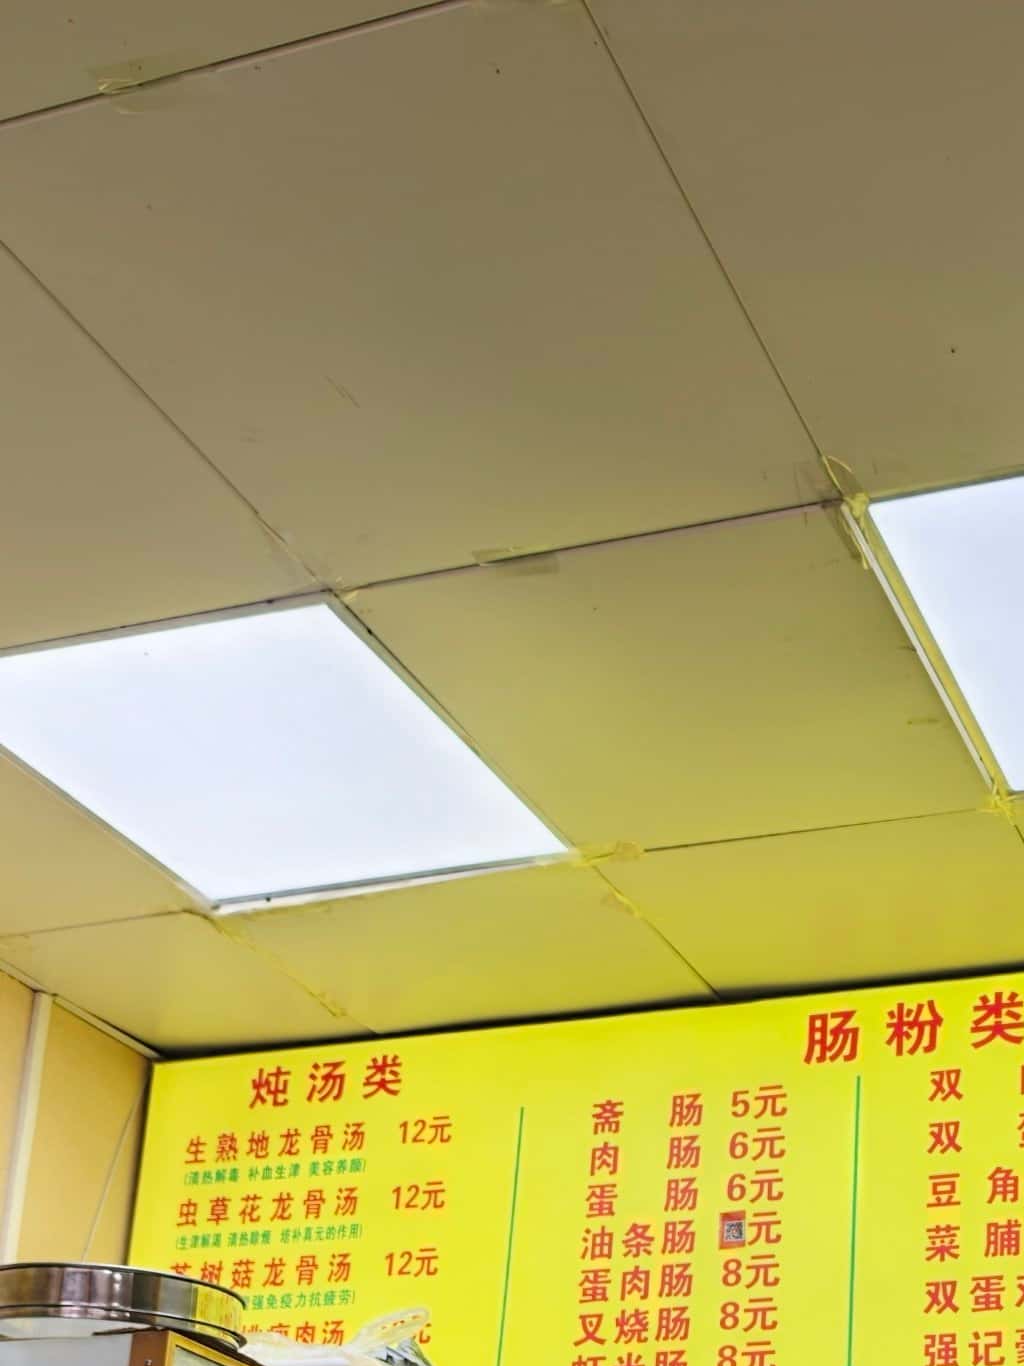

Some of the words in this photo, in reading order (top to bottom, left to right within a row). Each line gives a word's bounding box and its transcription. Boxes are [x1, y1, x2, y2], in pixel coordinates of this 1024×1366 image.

[249, 1055, 400, 1109] 炖汤类
[732, 1084, 787, 1118] 5元
[186, 1122, 365, 1164] 生熟地龙骨汤
[400, 1116, 450, 1144] 12元
[729, 1127, 785, 1160] 6元
[176, 1186, 359, 1227] 虫草花龙骨汤
[393, 1180, 445, 1210] 12元
[726, 1169, 783, 1202] 6元
[387, 1248, 437, 1276] 12元
[580, 1218, 696, 1261] 油条肠
[578, 1261, 694, 1305] 蛋肉肠
[721, 1254, 779, 1288] 8元
[573, 1305, 691, 1348] 叉烧肠
[720, 1297, 778, 1332] 8元
